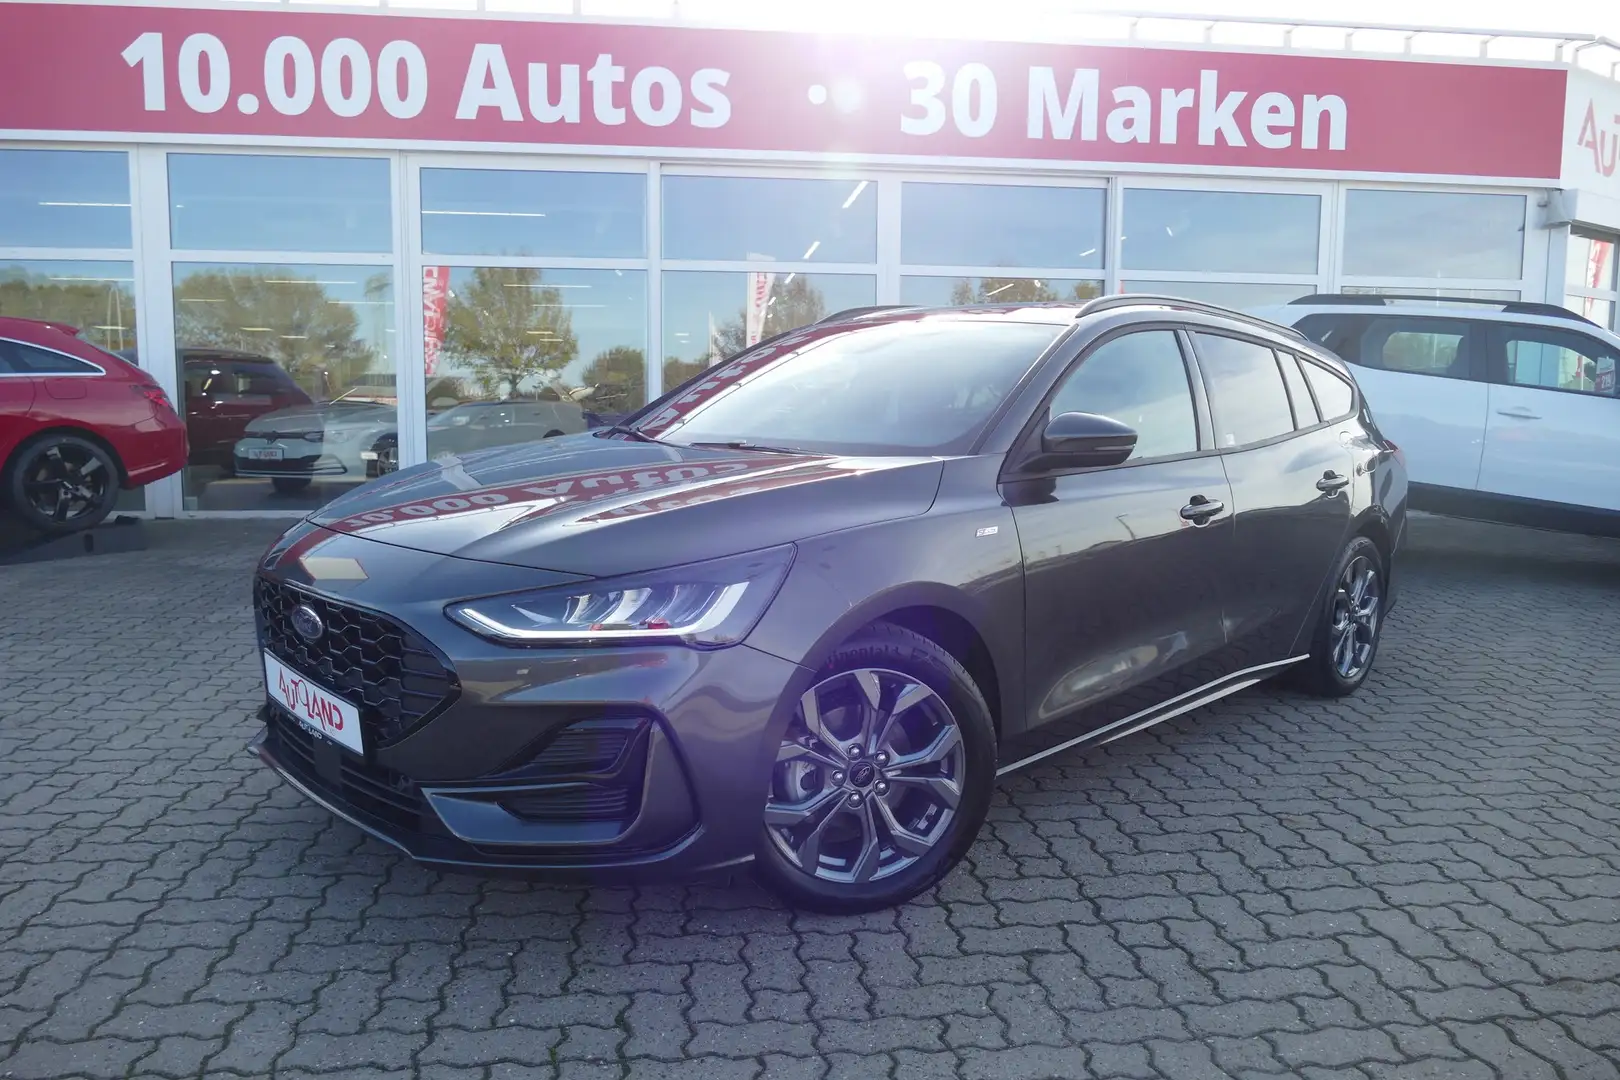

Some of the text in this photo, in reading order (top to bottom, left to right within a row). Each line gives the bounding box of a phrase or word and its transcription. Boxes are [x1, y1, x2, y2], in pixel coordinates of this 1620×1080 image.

[120, 31, 1349, 152] 10.000 Autos 30 Marken
[1577, 98, 1620, 178] AU
[279, 668, 344, 731] AUTOLAND
